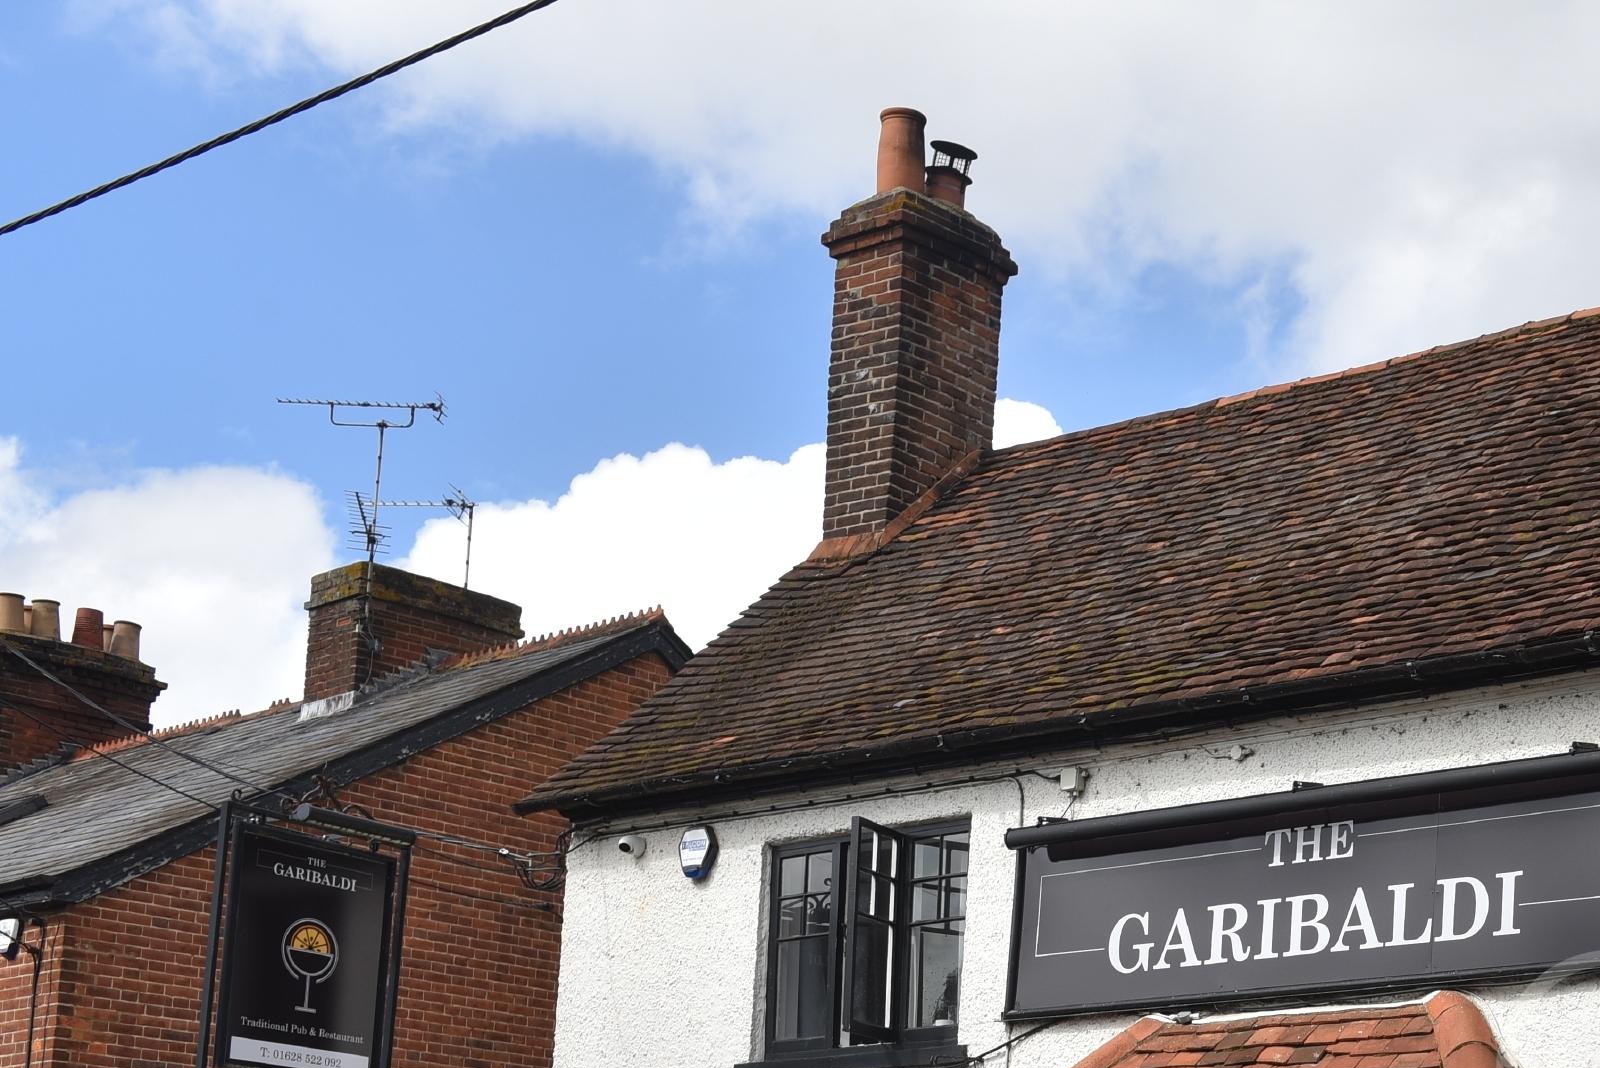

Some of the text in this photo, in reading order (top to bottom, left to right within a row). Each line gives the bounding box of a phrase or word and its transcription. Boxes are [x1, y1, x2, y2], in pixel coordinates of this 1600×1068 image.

[1264, 820, 1355, 868] THE
[273, 862, 357, 892] GARIBALDI
[307, 856, 327, 869] THE
[1107, 870, 1524, 974] GARIBALDI
[240, 1016, 364, 1044] Traditional Pub & Restaurant
[260, 1046, 342, 1068] T: 01628 522 092
